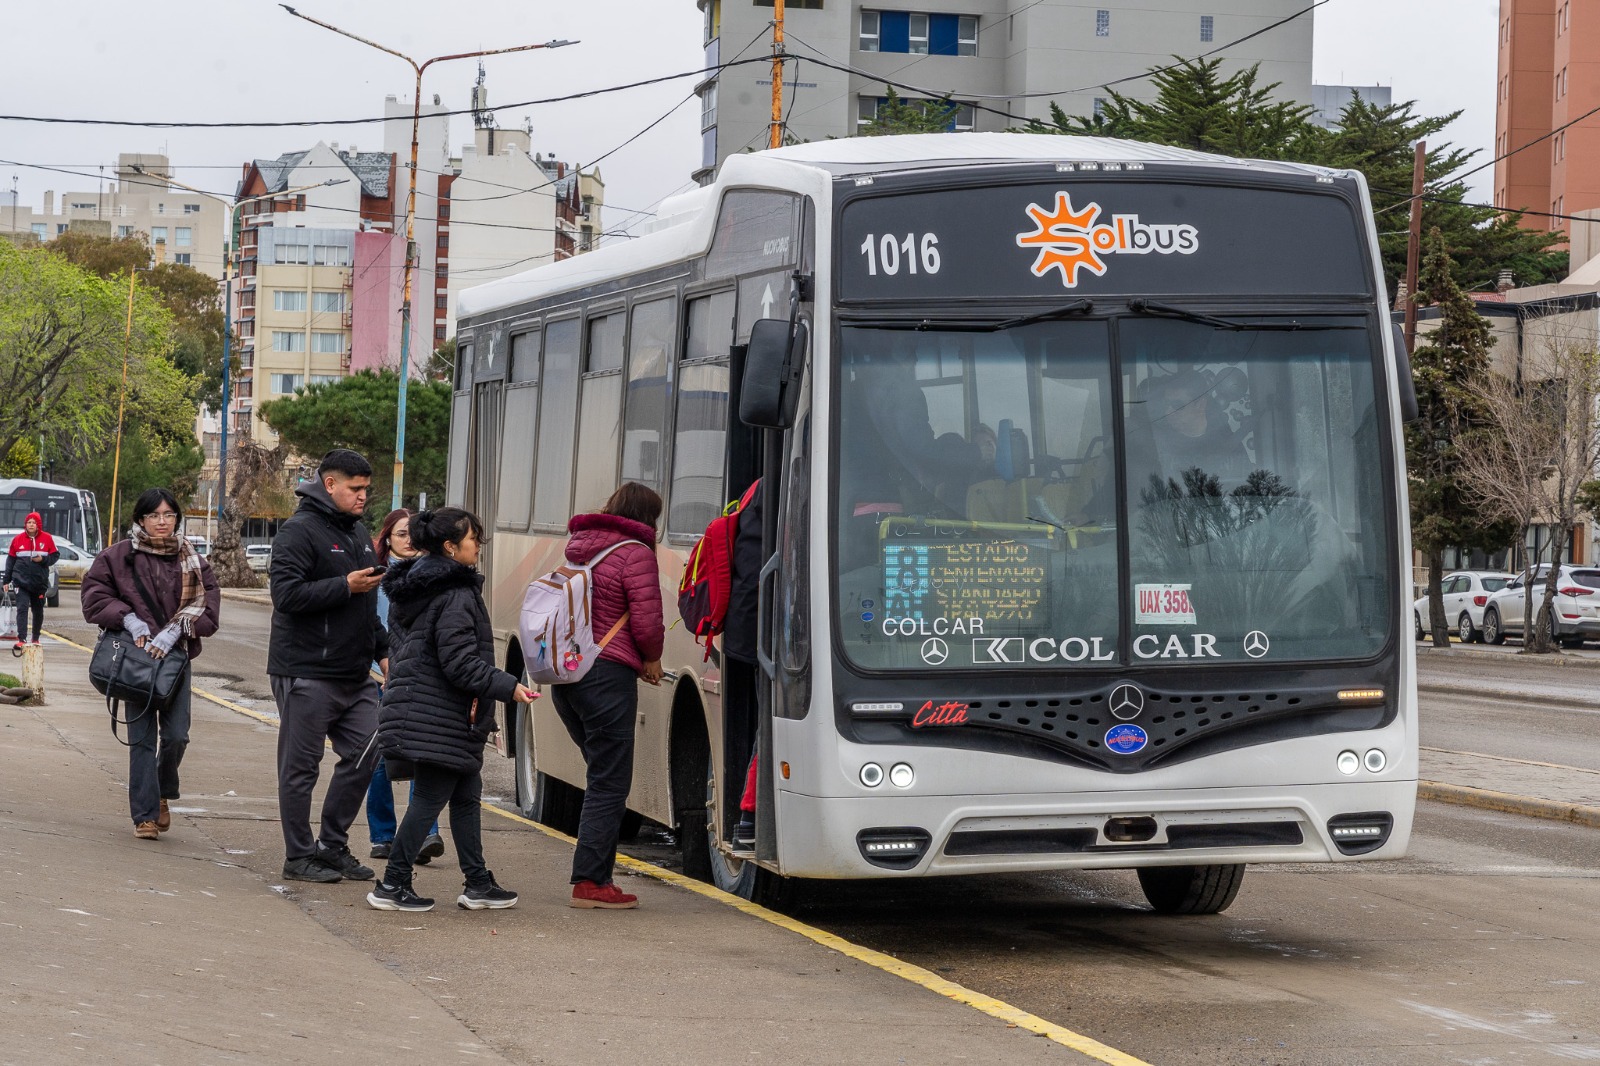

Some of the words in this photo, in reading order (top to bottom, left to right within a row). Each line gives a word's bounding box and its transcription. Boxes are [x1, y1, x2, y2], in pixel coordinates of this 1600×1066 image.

[861, 233, 940, 275] 1016
[882, 617, 984, 636] COLCAR
[1029, 637, 1115, 662] COL
[1133, 633, 1221, 658] CAR
